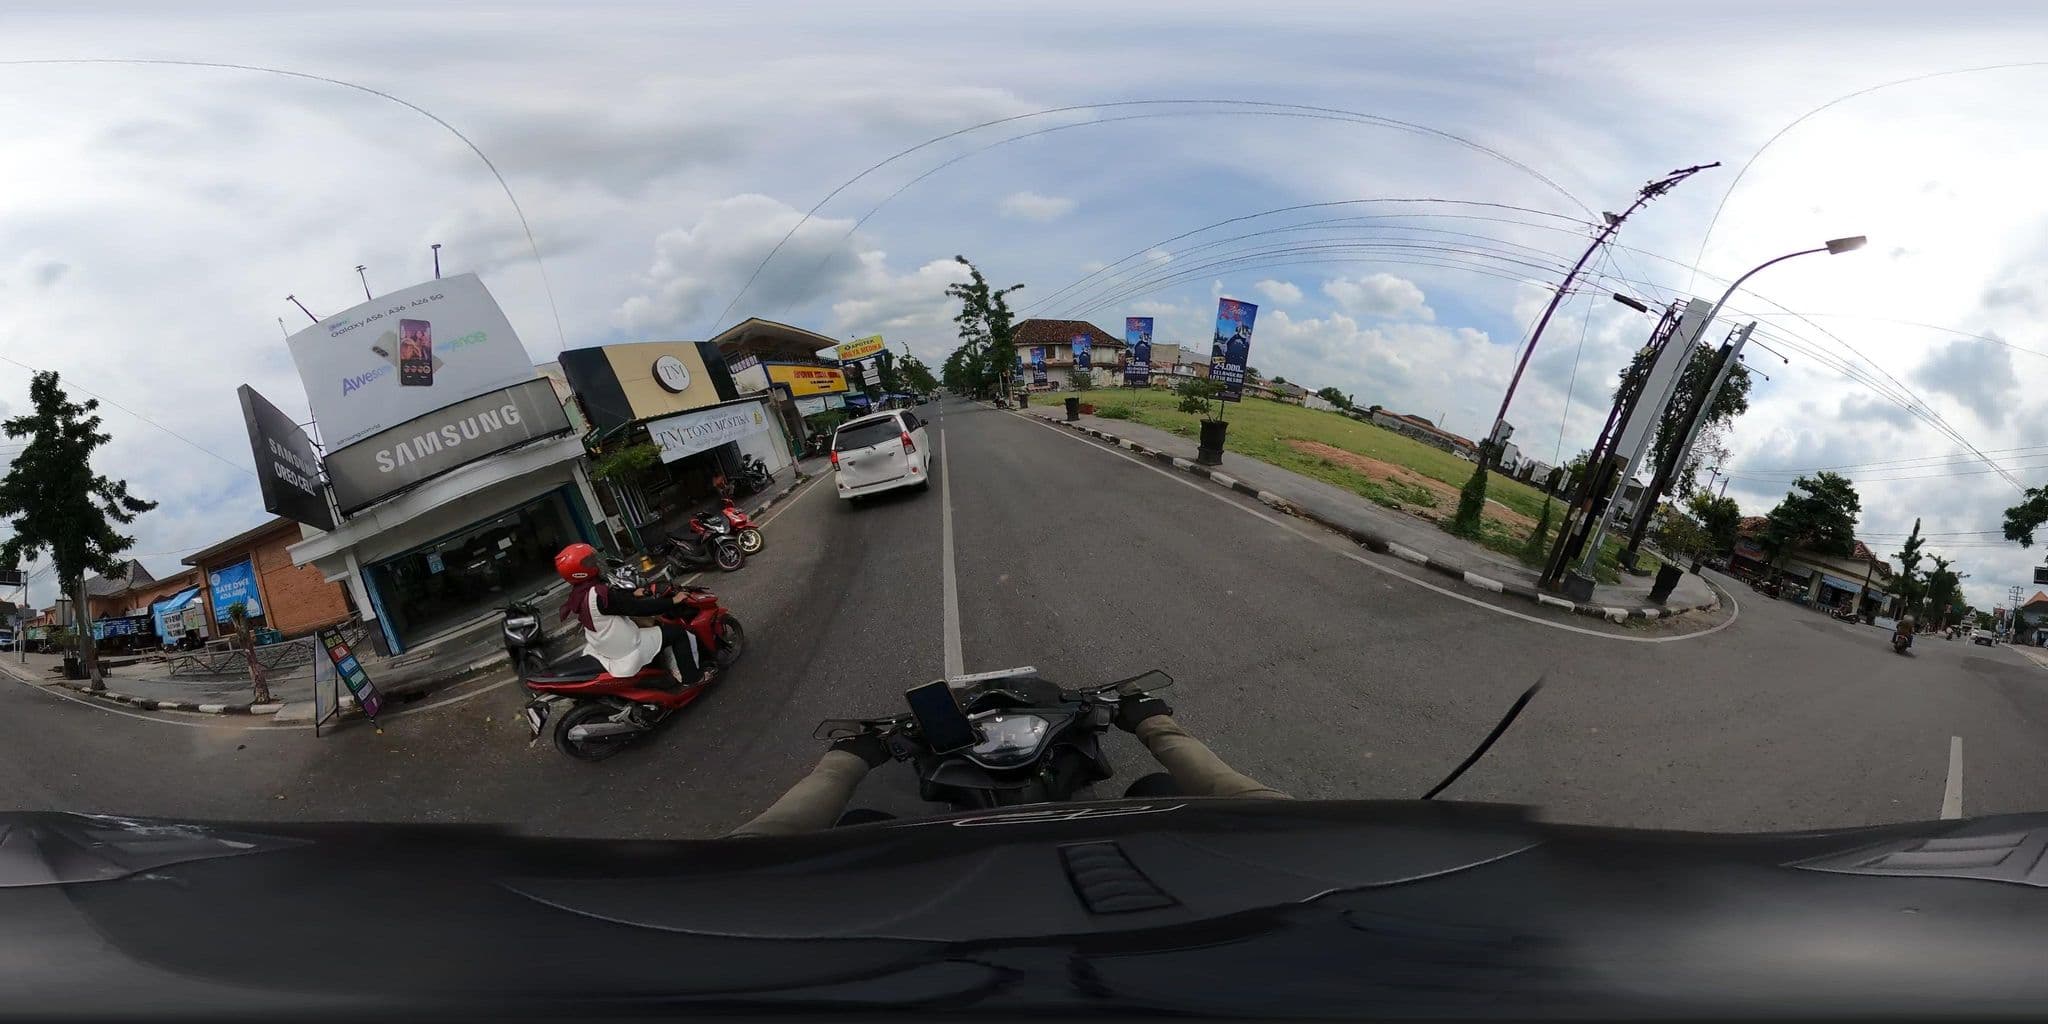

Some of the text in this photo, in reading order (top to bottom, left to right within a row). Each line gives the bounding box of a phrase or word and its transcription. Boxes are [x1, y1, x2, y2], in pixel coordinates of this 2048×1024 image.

[331, 319, 366, 338] Galaxy
[388, 305, 406, 316] A36
[851, 339, 874, 350] APOTEK
[663, 364, 686, 380] TM
[375, 404, 521, 473] SAMSUNG
[656, 427, 685, 452] TM
[683, 421, 715, 440] TONY
[269, 437, 315, 477] SAMSUN
